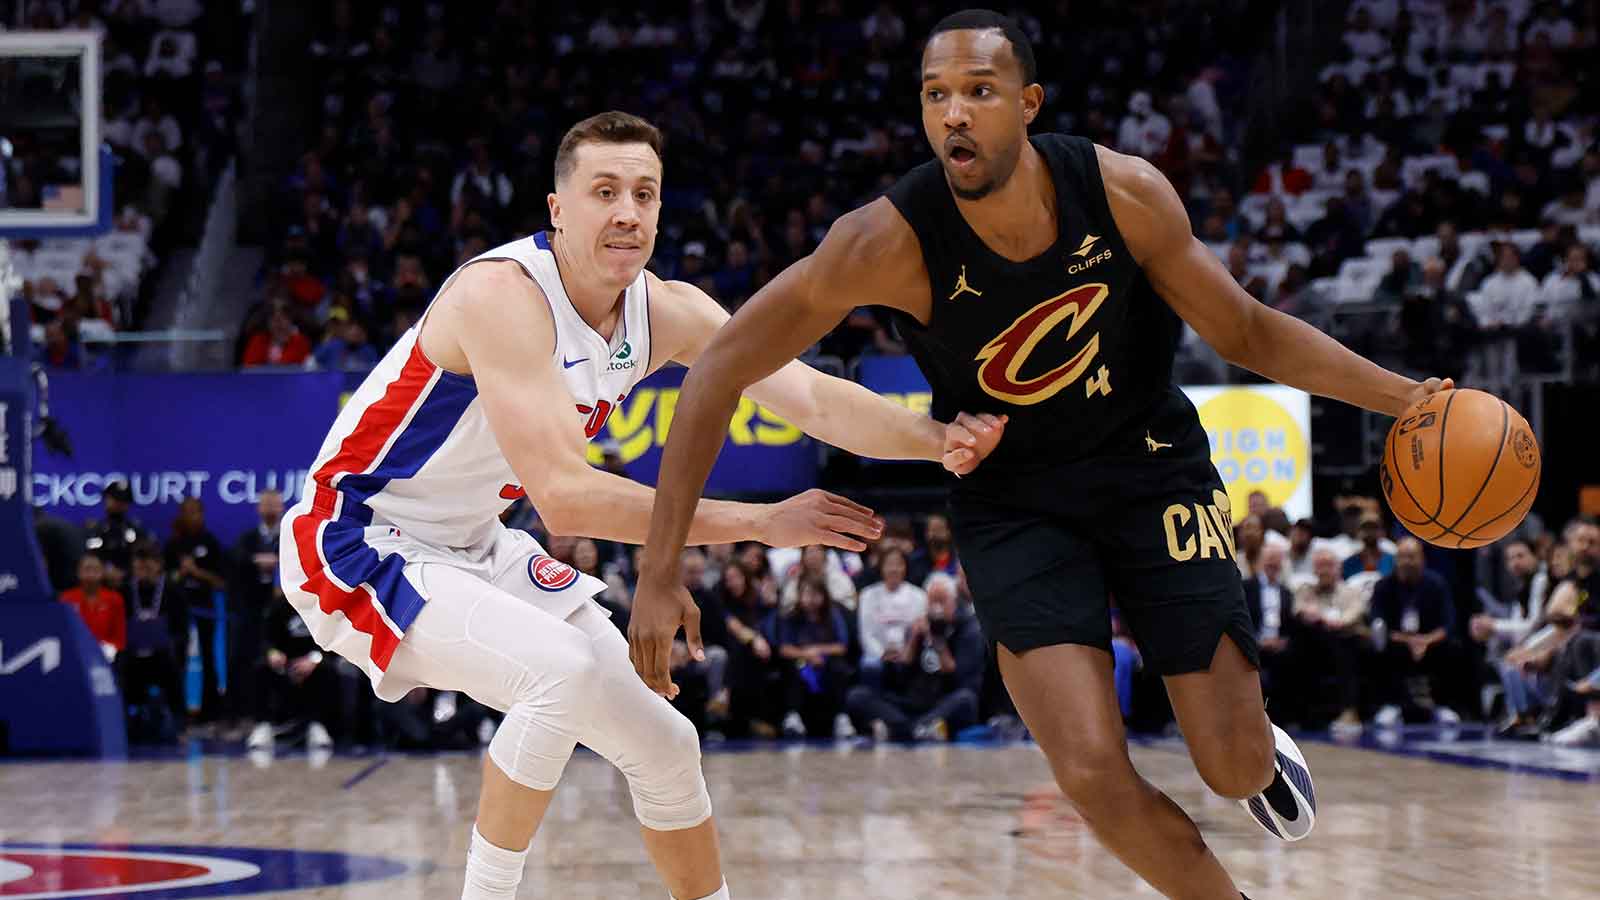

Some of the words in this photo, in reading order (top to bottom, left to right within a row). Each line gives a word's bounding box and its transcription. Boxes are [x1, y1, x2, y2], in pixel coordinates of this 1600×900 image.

[1068, 249, 1112, 274] CLIFFS
[1086, 364, 1112, 398] 4
[217, 469, 309, 504] CLU
